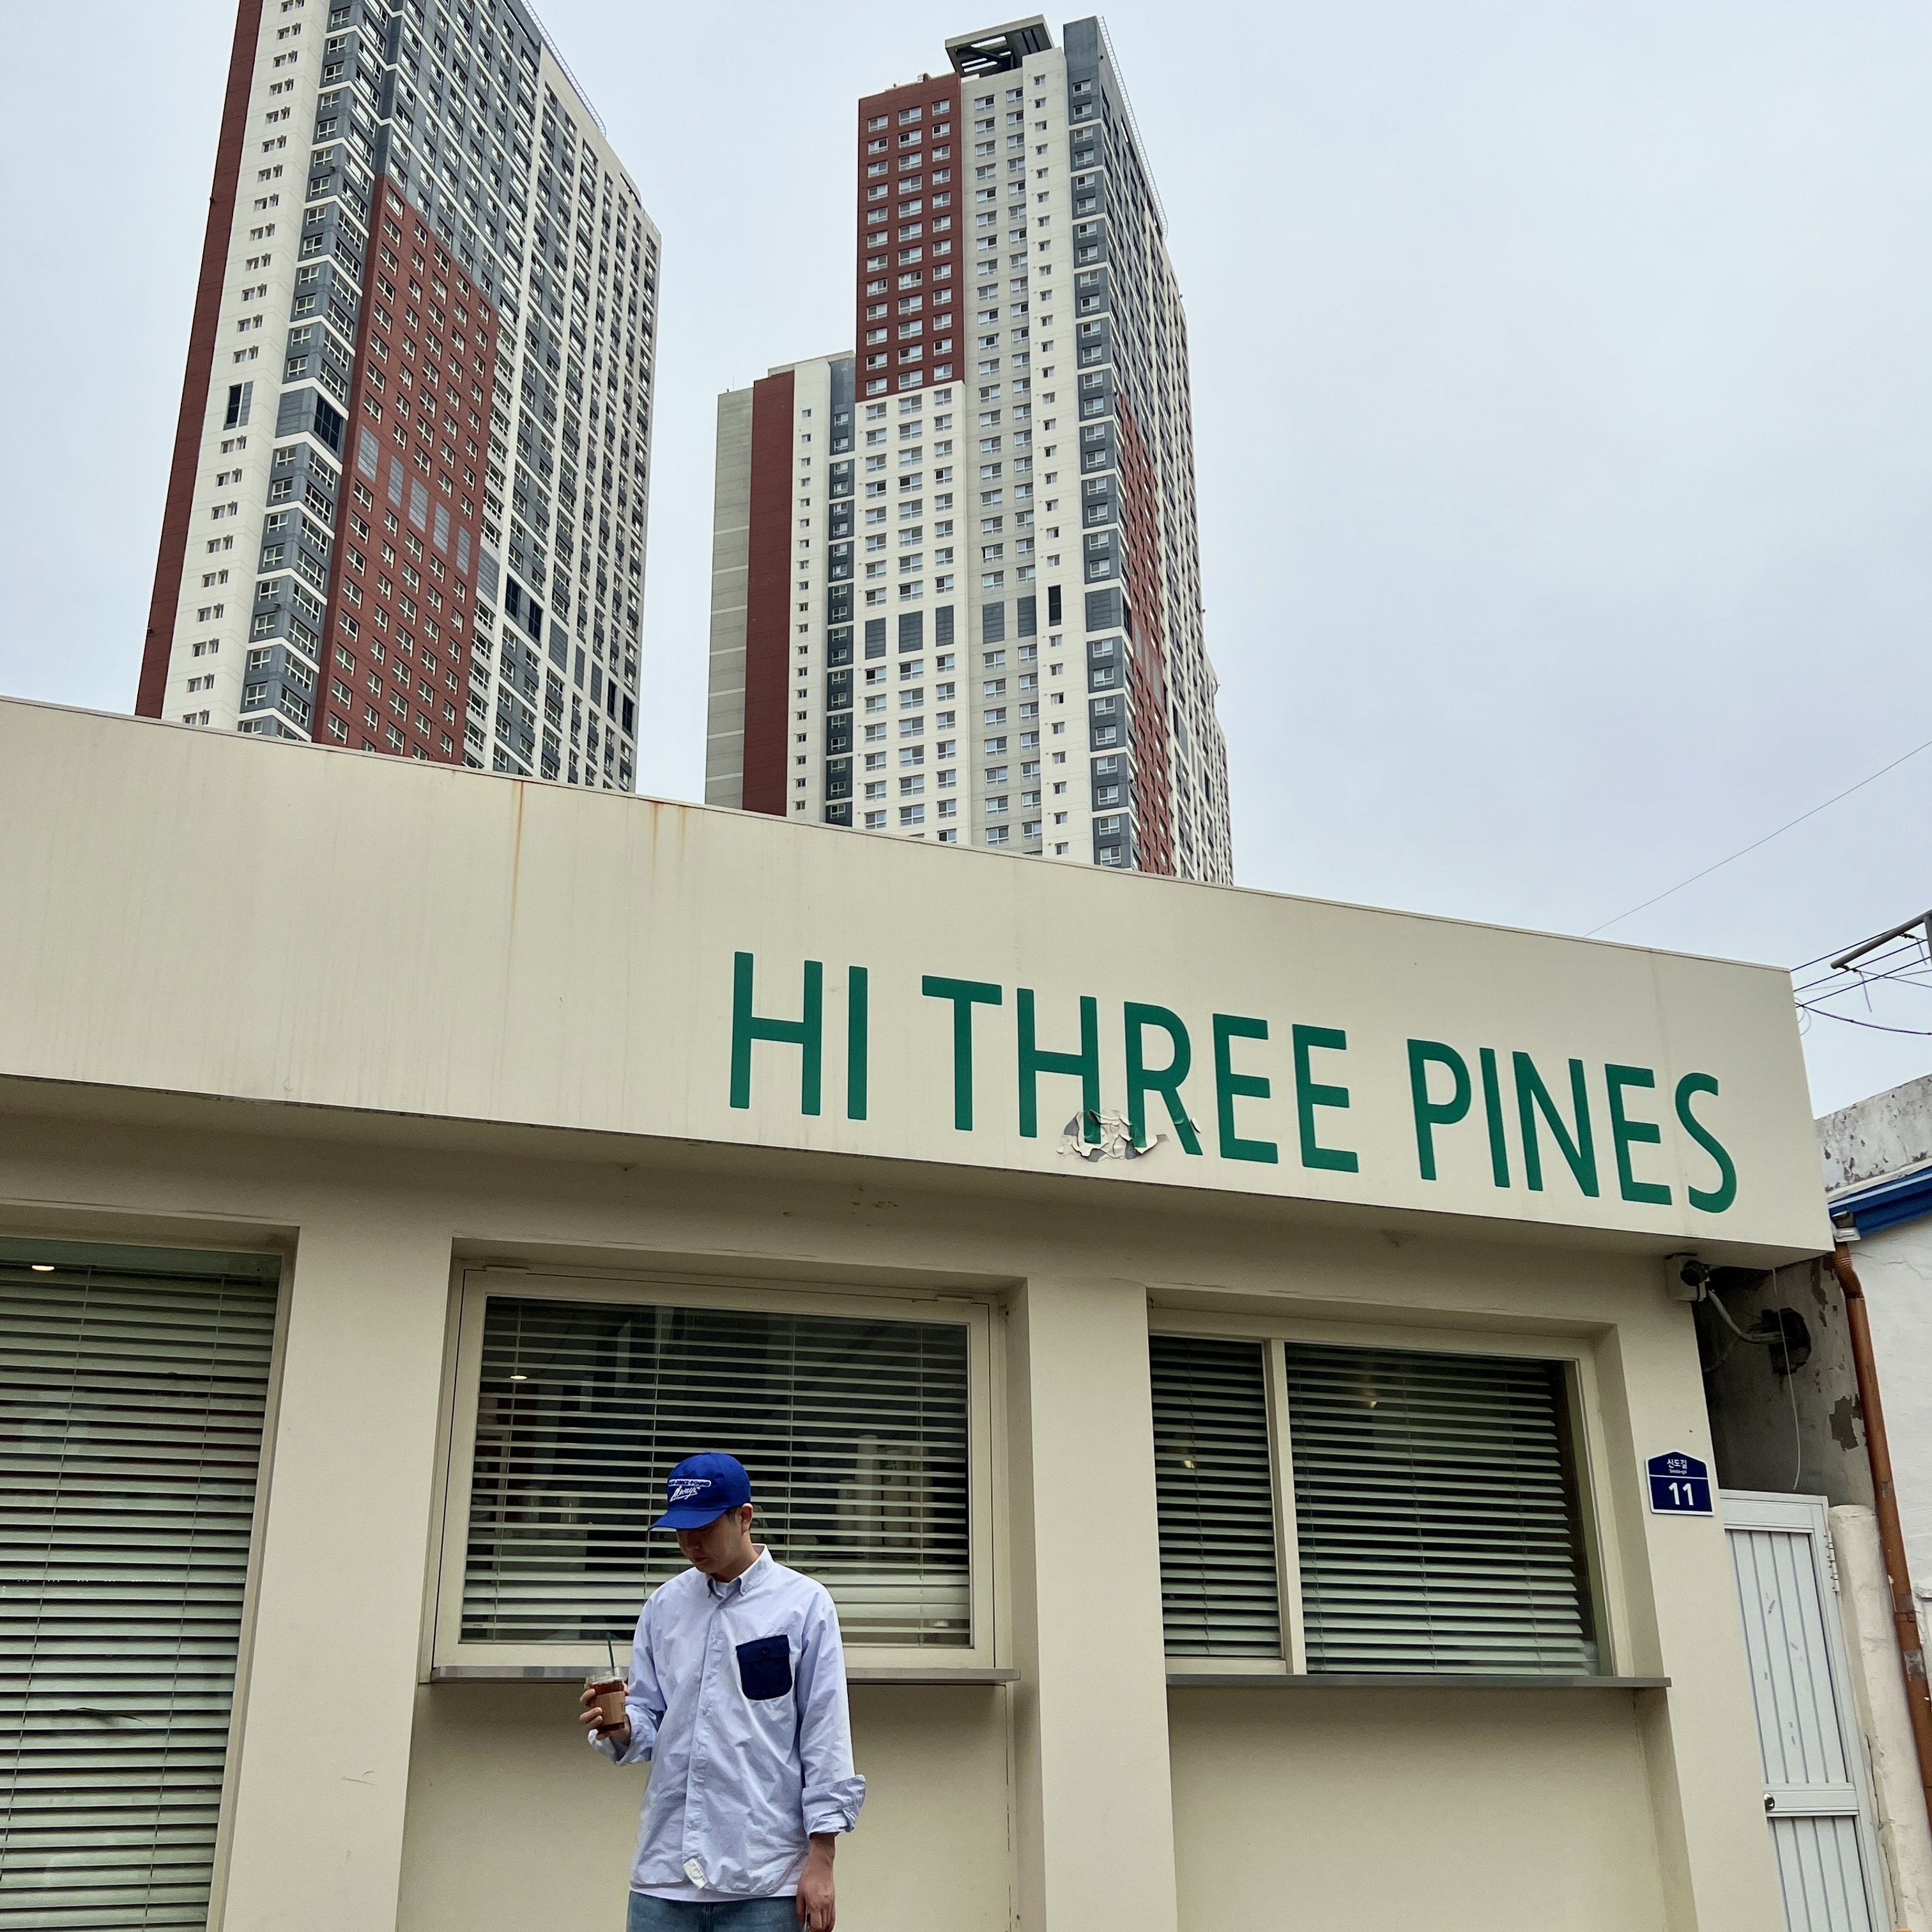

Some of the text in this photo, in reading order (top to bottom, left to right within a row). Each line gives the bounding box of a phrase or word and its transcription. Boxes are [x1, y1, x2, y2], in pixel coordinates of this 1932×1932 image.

[730, 953, 1736, 1213] HI THREE PINES
[1666, 1459, 1688, 1469] 신도길
[1668, 1482, 1694, 1506] 11
